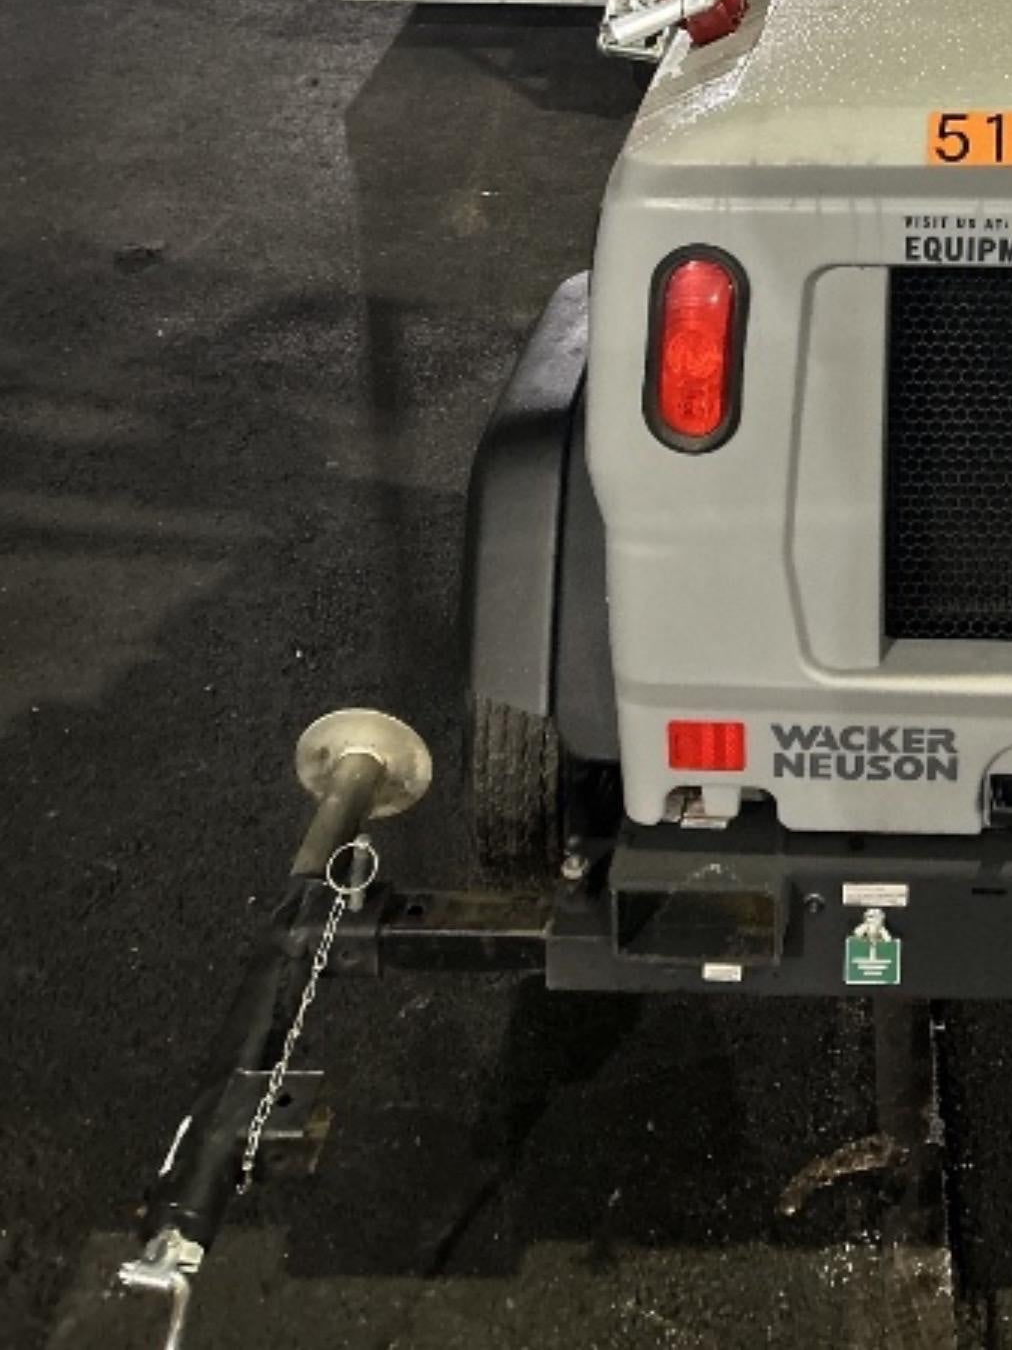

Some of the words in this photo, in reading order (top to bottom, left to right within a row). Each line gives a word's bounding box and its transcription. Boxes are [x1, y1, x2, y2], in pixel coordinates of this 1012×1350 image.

[904, 215, 948, 229] VISIT
[956, 217, 976, 229] US
[772, 725, 956, 753] WACKER
[775, 754, 958, 781] NEUSON
